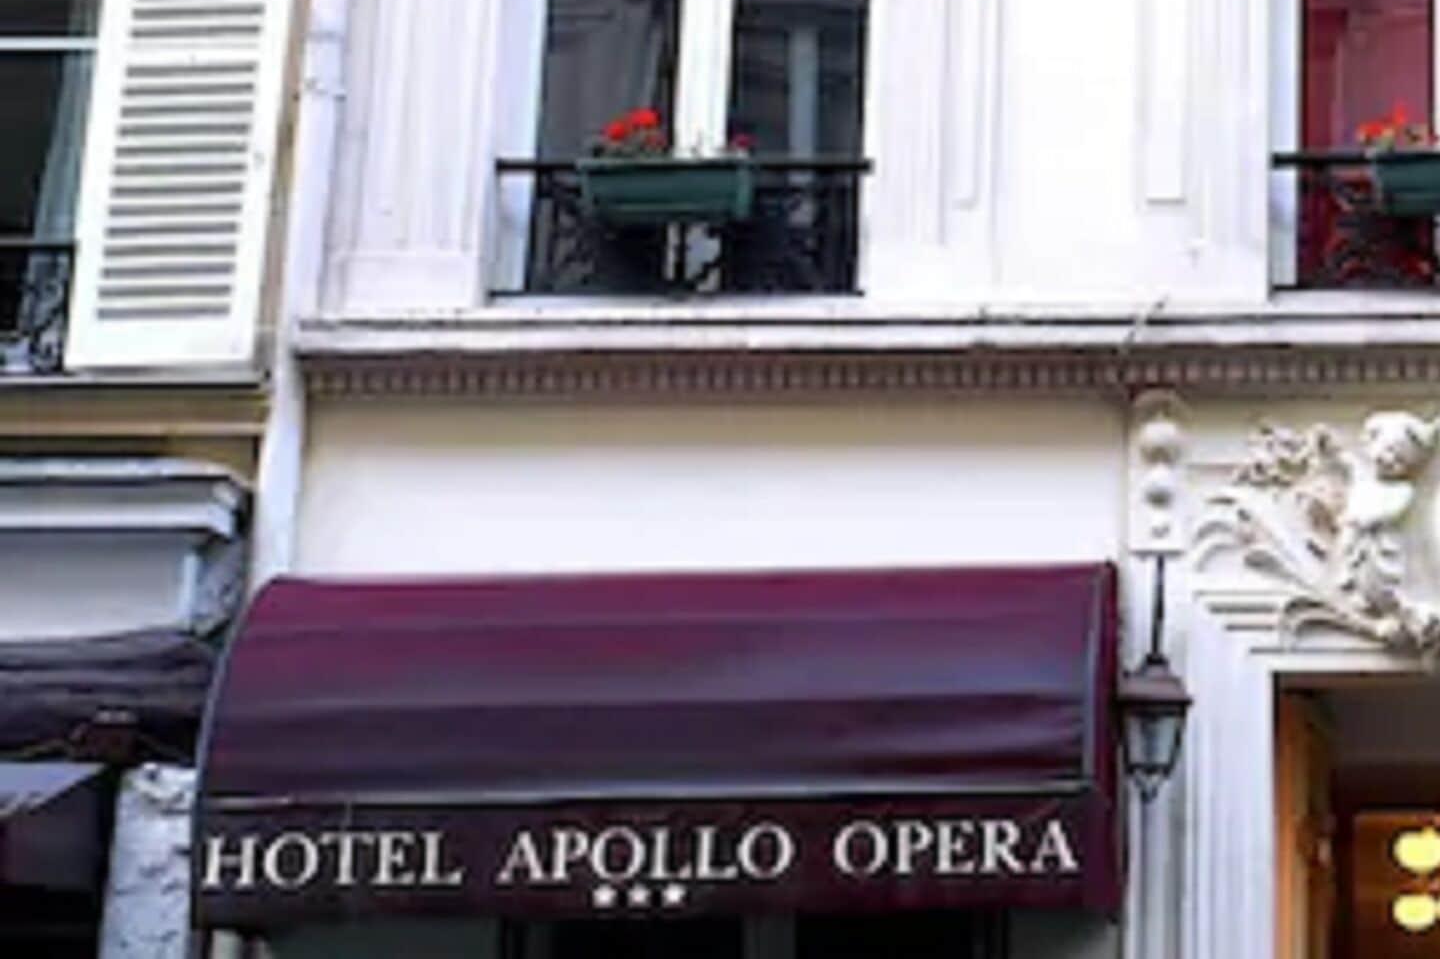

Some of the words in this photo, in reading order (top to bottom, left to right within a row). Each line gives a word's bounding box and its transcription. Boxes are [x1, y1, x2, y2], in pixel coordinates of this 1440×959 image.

[203, 831, 463, 888] HOTEL
[495, 823, 796, 883] APOLLO
[833, 818, 1079, 875] OPERA
